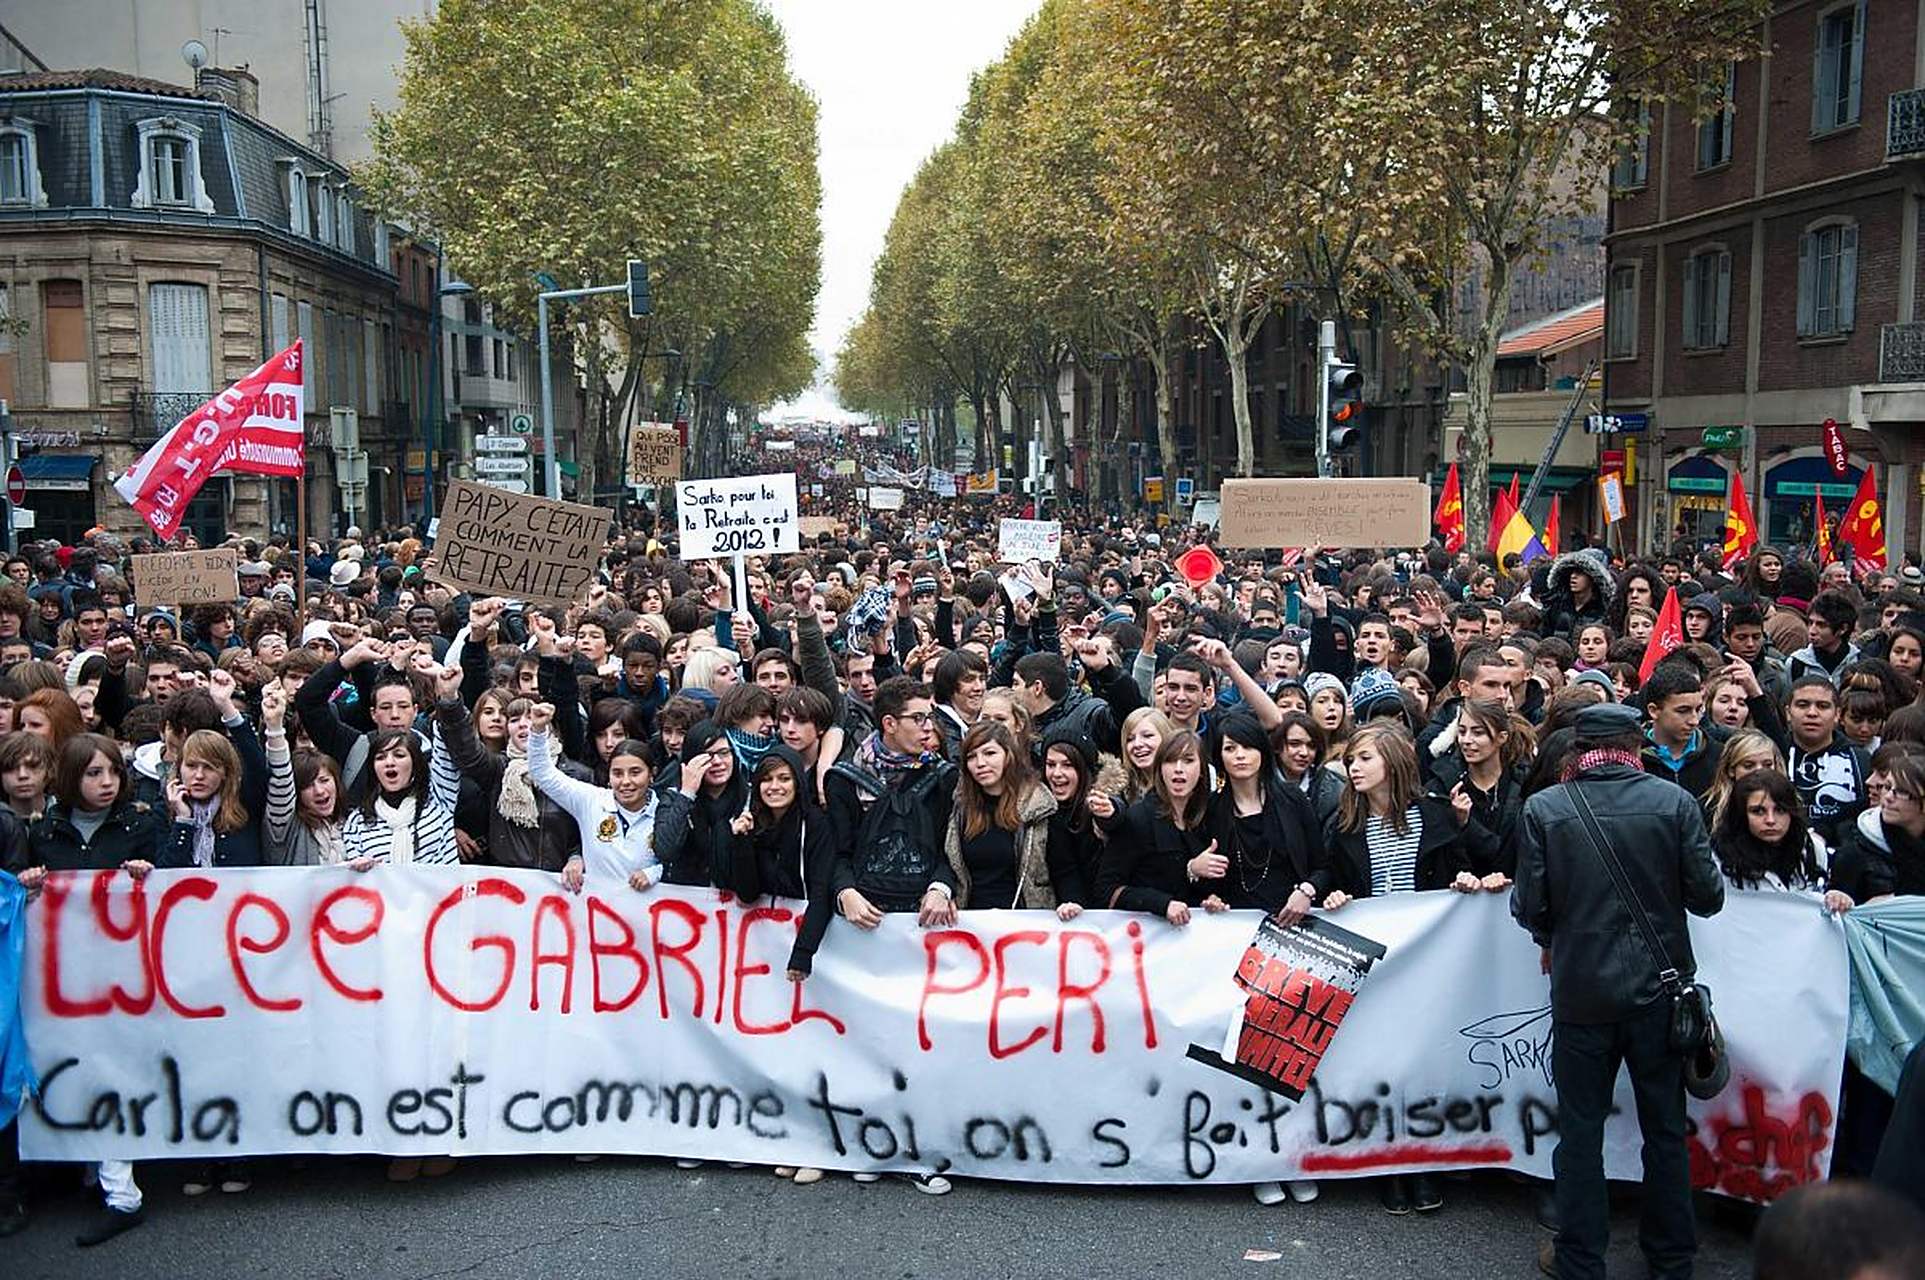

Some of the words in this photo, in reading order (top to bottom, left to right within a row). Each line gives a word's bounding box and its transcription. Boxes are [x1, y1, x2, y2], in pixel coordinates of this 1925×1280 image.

[634, 452, 670, 466] PREND
[1828, 426, 1847, 471] TABAC
[730, 492, 756, 507] pour
[703, 508, 756, 529] Retraite
[456, 520, 562, 555] COMMENT
[567, 544, 589, 561] LA
[711, 529, 765, 552] 2012
[440, 539, 592, 599] RETRAITE?
[35, 1055, 240, 1146] Carla
[290, 1088, 364, 1137] on
[385, 1060, 486, 1140] est
[964, 1114, 1052, 1163] on
